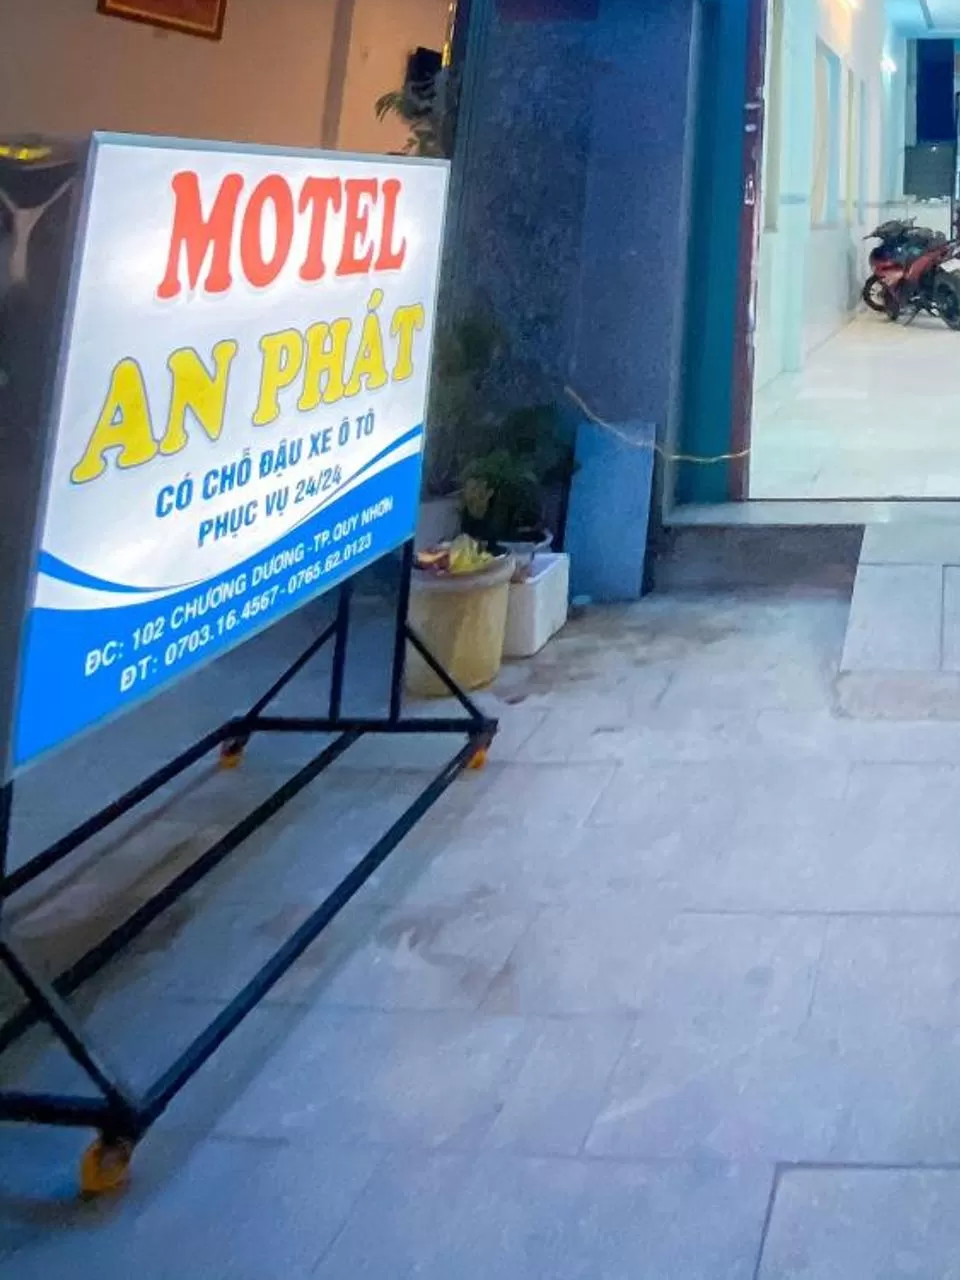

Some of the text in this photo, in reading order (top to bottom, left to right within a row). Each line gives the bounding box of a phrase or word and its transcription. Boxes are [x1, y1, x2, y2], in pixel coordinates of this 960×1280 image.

[155, 169, 408, 300] MOTEL
[71, 288, 426, 484] AN PHÁT
[156, 407, 376, 518] CÓ CHỖ ĐẬU XE Ô TÔ
[198, 464, 343, 548] PHỤC VỤ 24/24
[84, 639, 125, 677] ĐC:
[131, 615, 166, 651] 102
[119, 655, 158, 693] ĐT:
